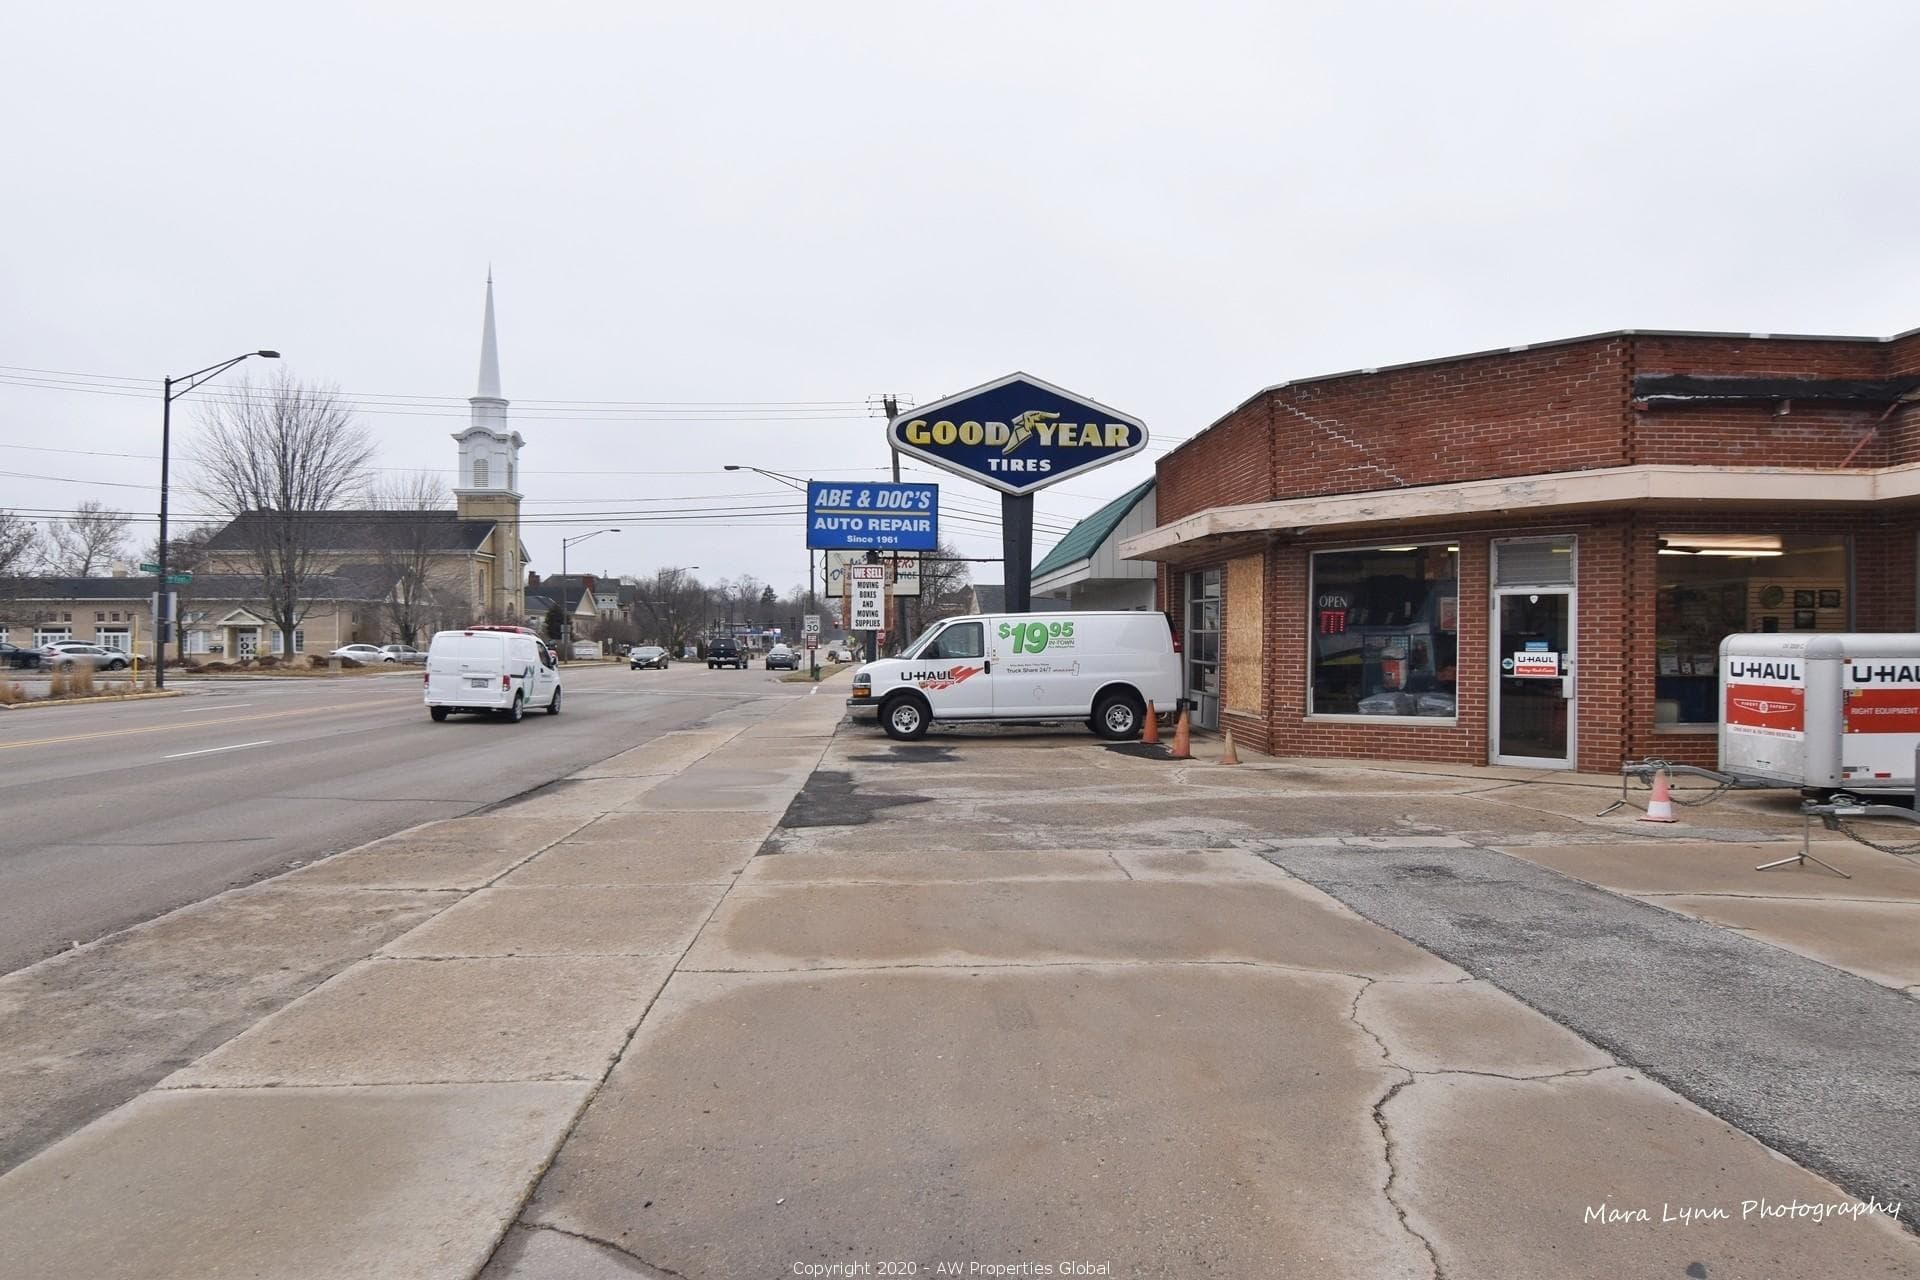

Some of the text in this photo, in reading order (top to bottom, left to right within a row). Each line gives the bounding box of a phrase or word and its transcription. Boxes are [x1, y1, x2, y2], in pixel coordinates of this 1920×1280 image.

[988, 458, 1051, 472] TIRES
[815, 489, 931, 509] ABE & DOC'S
[814, 518, 931, 532] AUTO REPAIR
[847, 535, 898, 544] Since 1961
[853, 567, 866, 578] WE
[866, 567, 883, 578] SELL
[857, 581, 879, 589] MOVING
[1319, 595, 1348, 608] OPEN
[806, 624, 819, 632] 30
[855, 619, 880, 627] SUPPLIES
[901, 671, 954, 681] U-HAUL
[1730, 662, 1801, 680] U-HAUL
[1852, 665, 1920, 682] U-HA
[1851, 707, 1919, 715] RIGHT EQUIPMENT
